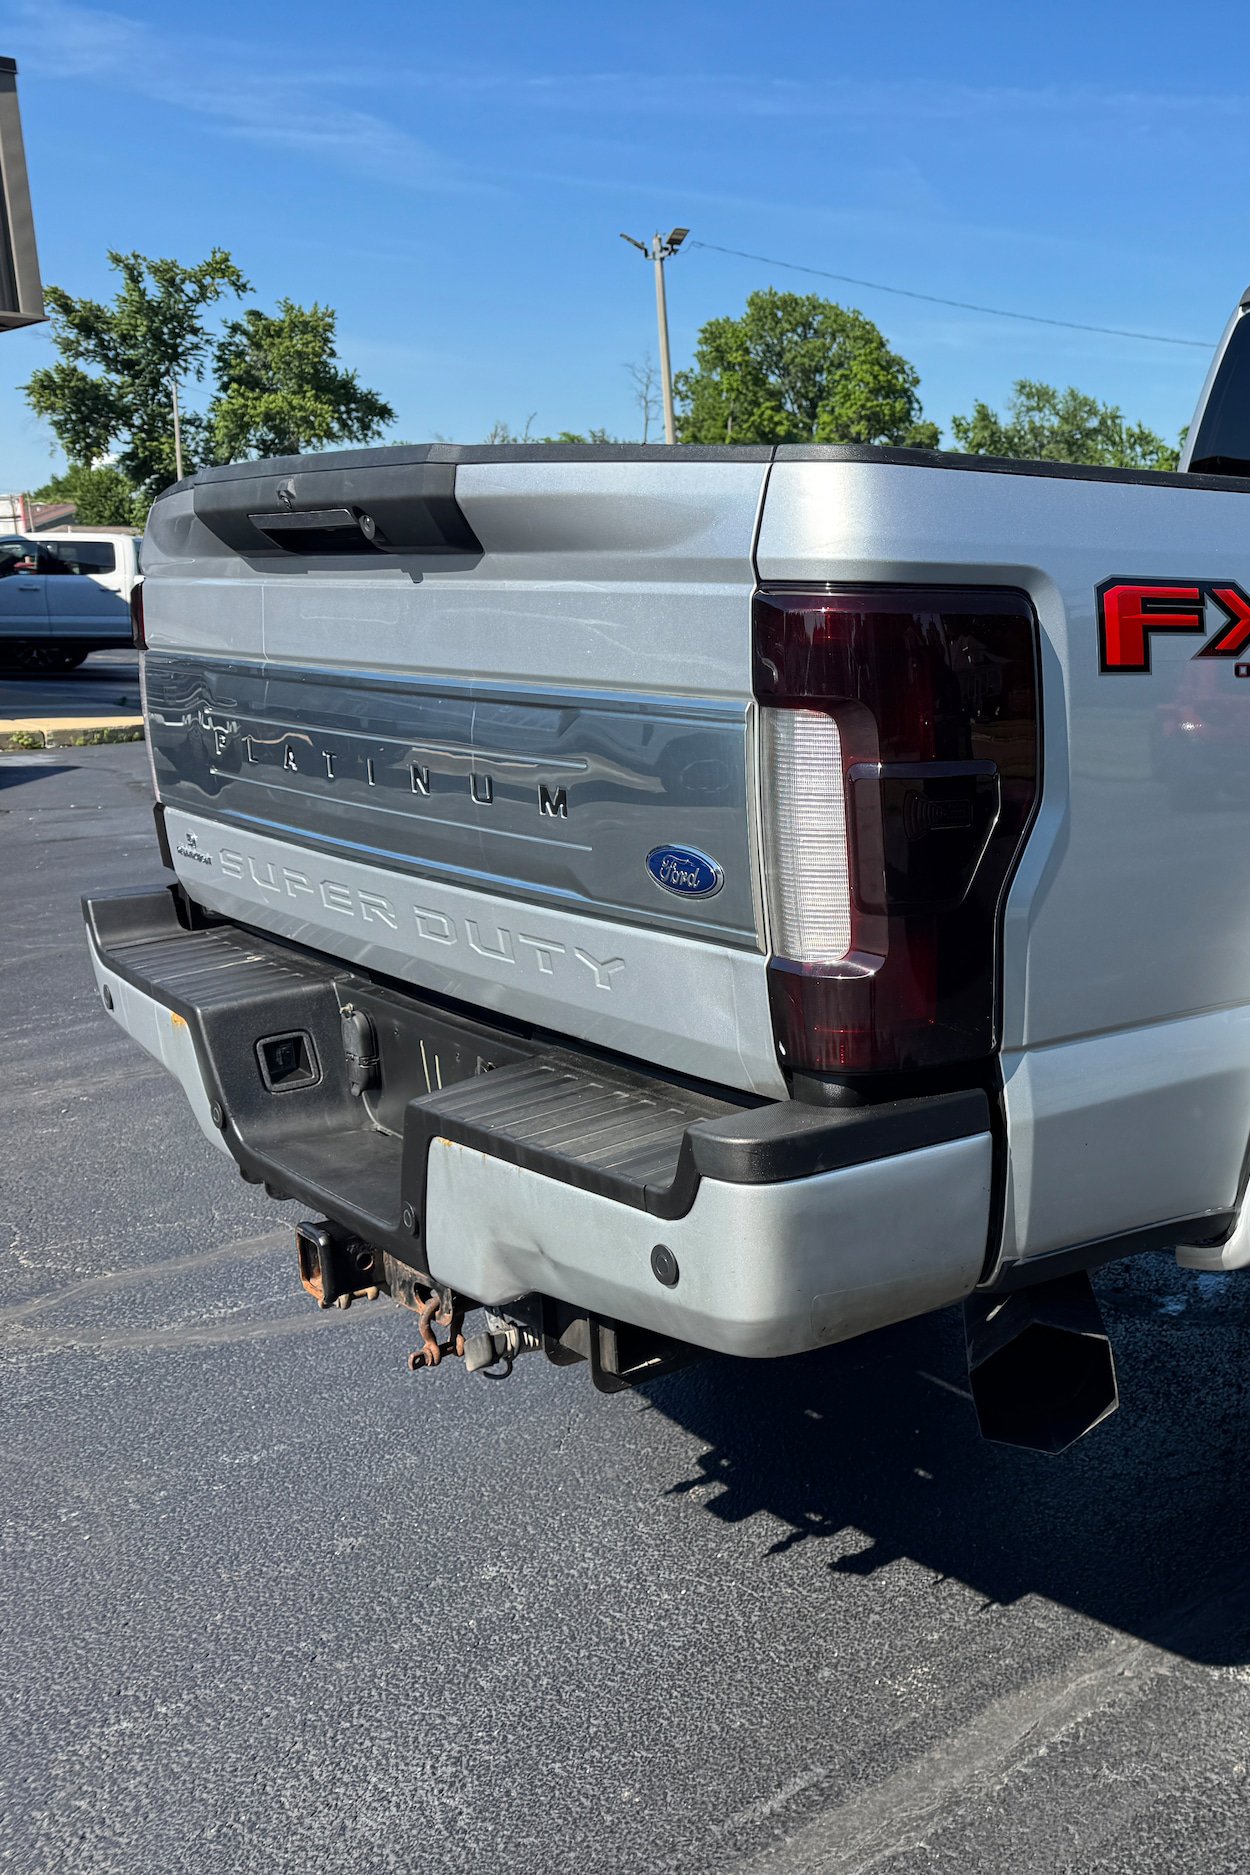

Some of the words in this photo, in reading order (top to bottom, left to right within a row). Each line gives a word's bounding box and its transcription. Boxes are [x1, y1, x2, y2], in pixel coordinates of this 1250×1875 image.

[213, 729, 569, 820] PLATINUM
[218, 847, 398, 930] SUPER
[413, 905, 625, 991] DUTY
